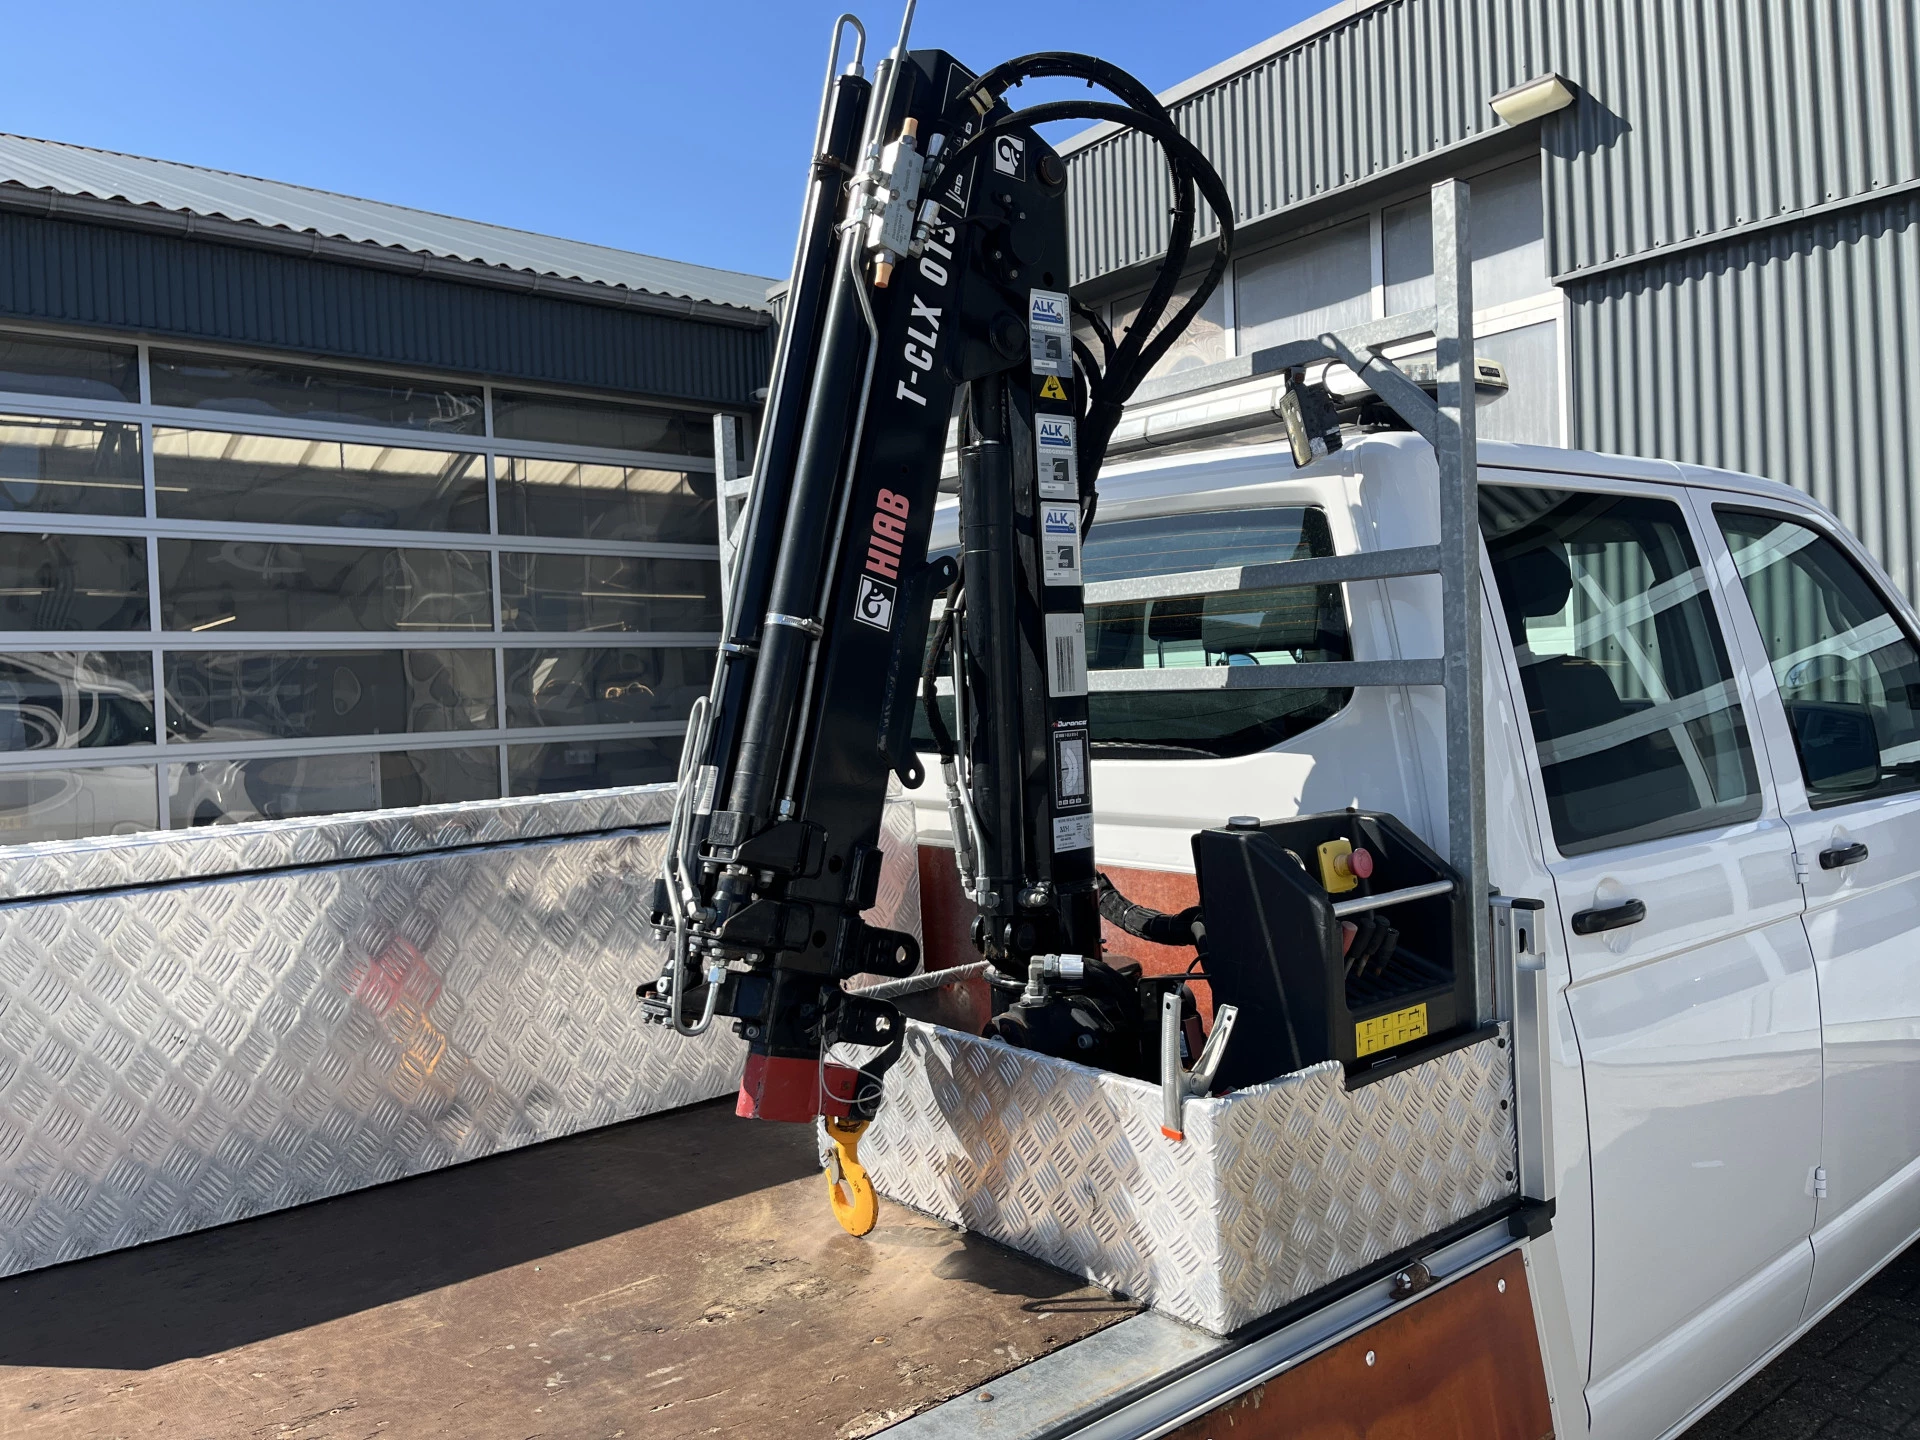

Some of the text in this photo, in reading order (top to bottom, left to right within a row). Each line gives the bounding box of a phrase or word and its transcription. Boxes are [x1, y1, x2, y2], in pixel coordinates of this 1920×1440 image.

[1032, 299, 1055, 314] ALK
[896, 294, 943, 407] T-CLX
[1040, 423, 1063, 437] ALK
[1045, 511, 1068, 525] ALK
[865, 488, 910, 580] HIAB
